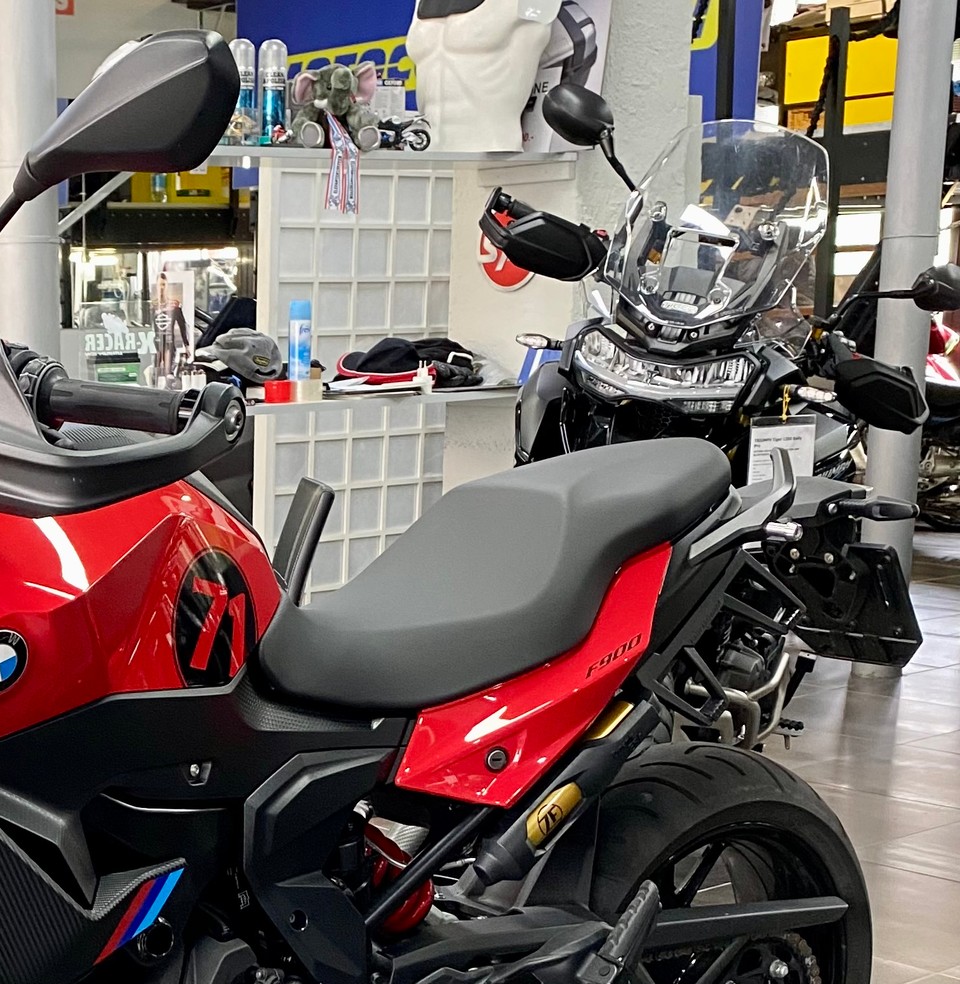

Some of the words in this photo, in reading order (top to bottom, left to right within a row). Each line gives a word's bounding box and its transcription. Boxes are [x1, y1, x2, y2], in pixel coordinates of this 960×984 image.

[190, 575, 246, 678] 71
[585, 632, 642, 680] F900
[538, 804, 559, 834] ZF
